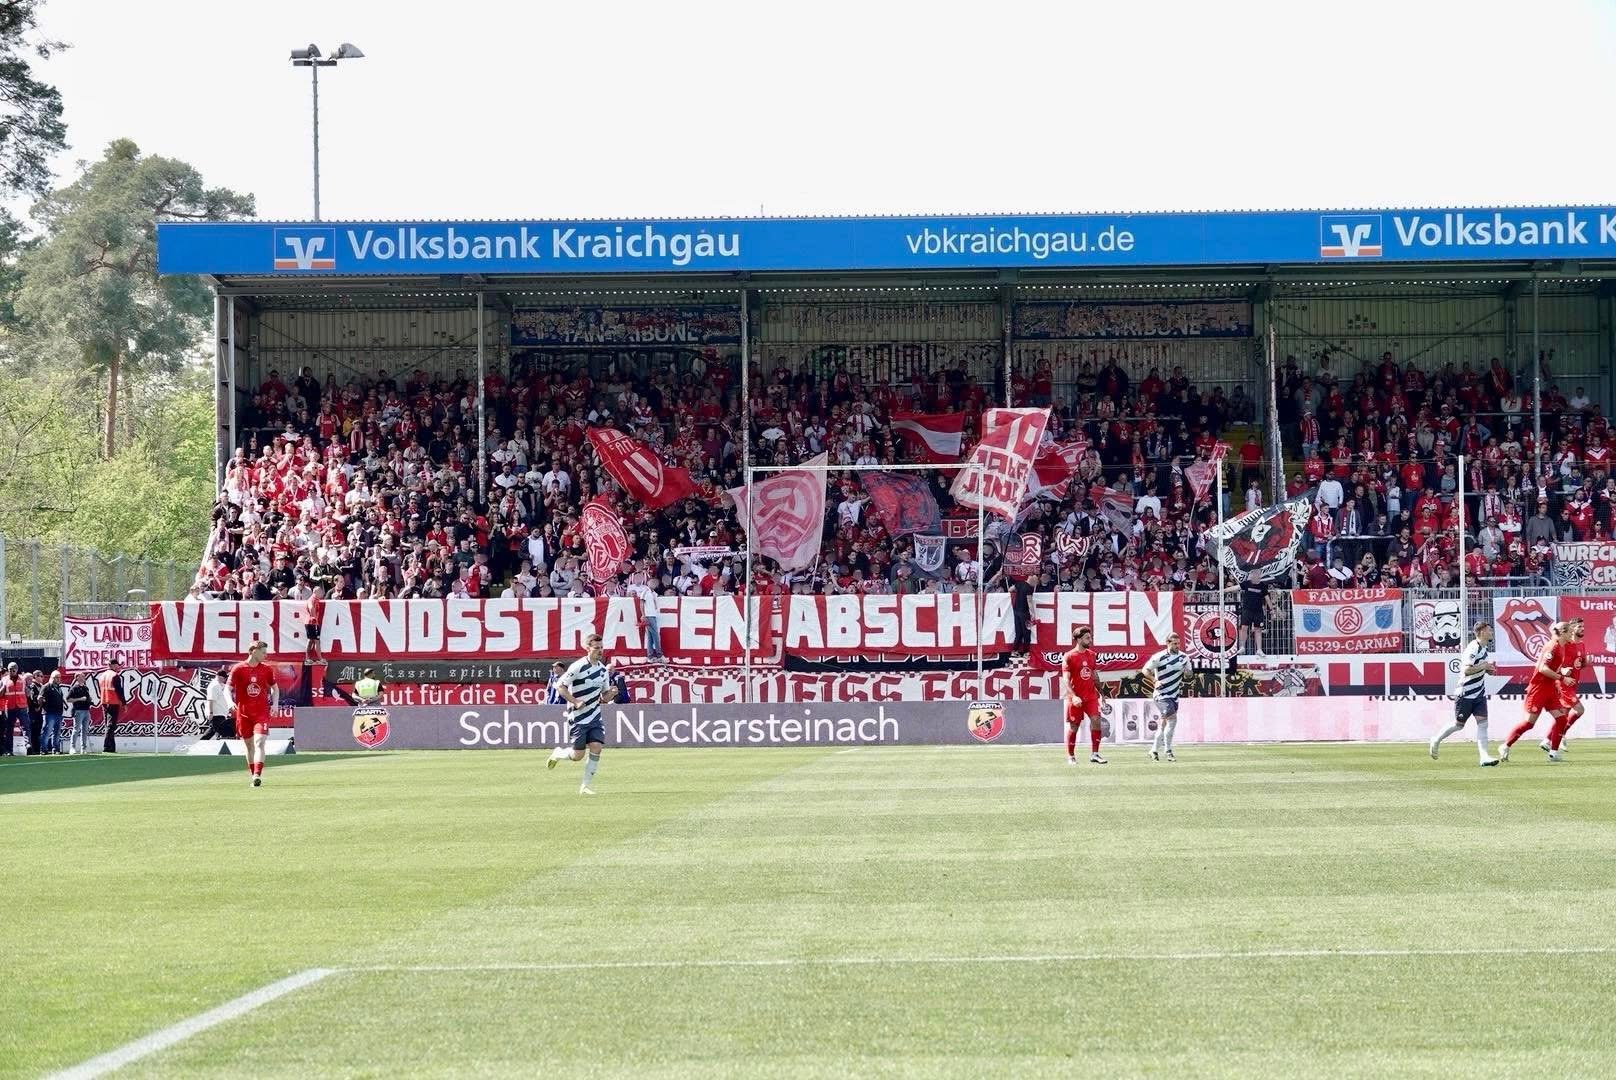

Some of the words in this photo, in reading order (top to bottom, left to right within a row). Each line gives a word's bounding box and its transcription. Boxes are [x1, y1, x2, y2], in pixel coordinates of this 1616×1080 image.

[1393, 212, 1588, 246] Volksbank
[347, 227, 540, 260] Volksbank
[552, 225, 739, 265] Kraichgau
[906, 226, 1134, 258] vbkraichgau.de
[1308, 589, 1386, 602] FANCLUB
[93, 625, 133, 643] LAND
[1299, 637, 1400, 652] 45329-CARNAP
[337, 665, 362, 684] Mi
[382, 663, 438, 683] Essen
[448, 663, 501, 681] spielt
[510, 668, 541, 678] man
[420, 684, 454, 706] für
[460, 685, 496, 705] die
[616, 707, 899, 745] Neckarsteinach
